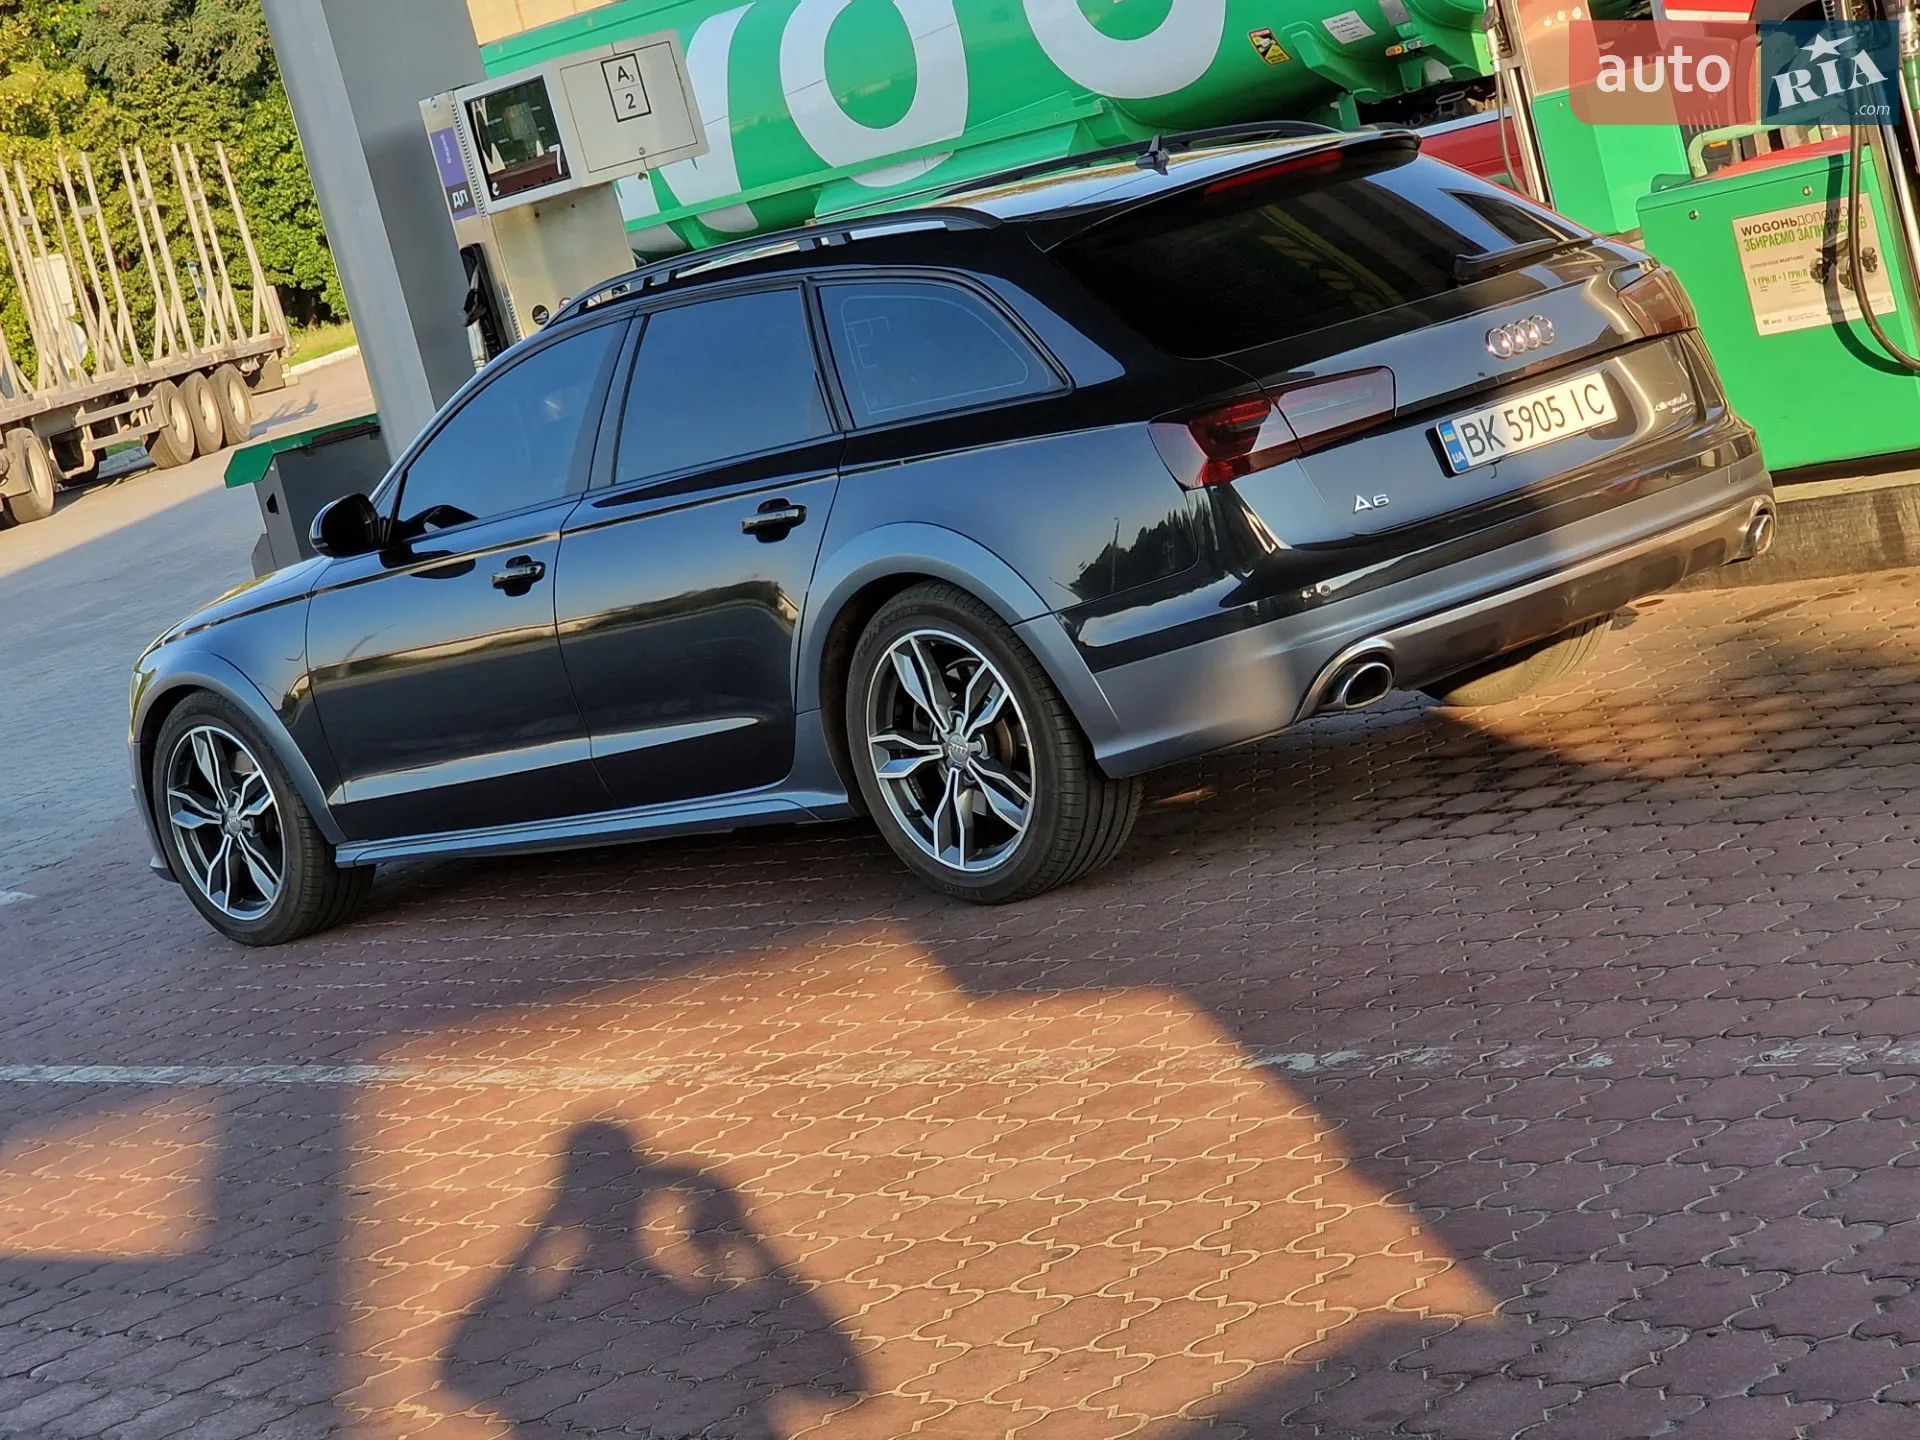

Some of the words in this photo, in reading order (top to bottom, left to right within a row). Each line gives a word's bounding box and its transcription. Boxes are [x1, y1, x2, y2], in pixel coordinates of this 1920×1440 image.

[625, 92, 637, 110] 2
[451, 188, 469, 209] ДП
[1743, 229, 1796, 252] ЗБИРАЄМО
[1460, 414, 1506, 458] BK
[1503, 395, 1566, 443] 5905
[1569, 383, 1605, 422] IC
[1452, 451, 1466, 464] UA
[1353, 493, 1390, 515] A6
